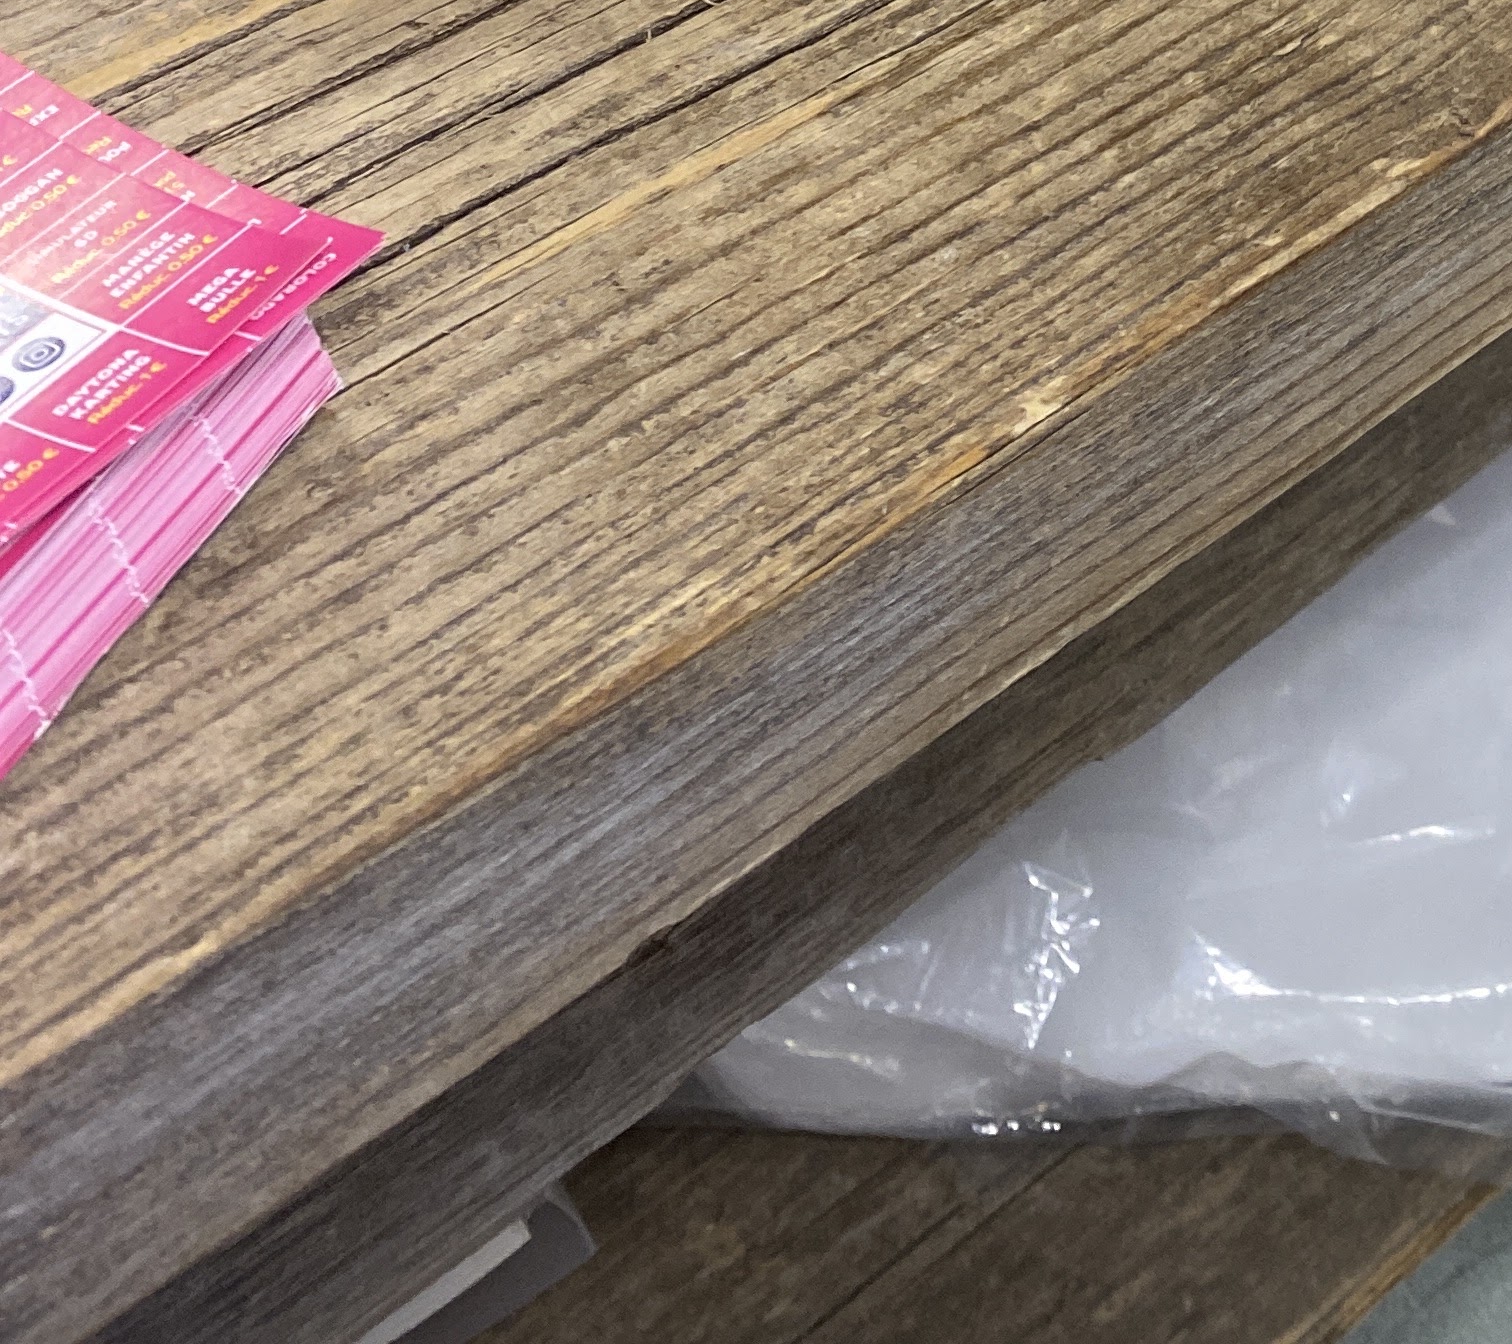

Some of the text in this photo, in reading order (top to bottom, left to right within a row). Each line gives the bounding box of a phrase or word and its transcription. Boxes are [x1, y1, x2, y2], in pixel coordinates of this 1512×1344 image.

[0, 168, 64, 220] OGGAN
[102, 231, 176, 288] MANÈGE
[109, 232, 196, 298] ENFANTIN
[186, 267, 241, 306] MEGA
[199, 268, 257, 313] BULLE
[52, 348, 140, 417] DAYTONA
[68, 355, 152, 421] KARTING
